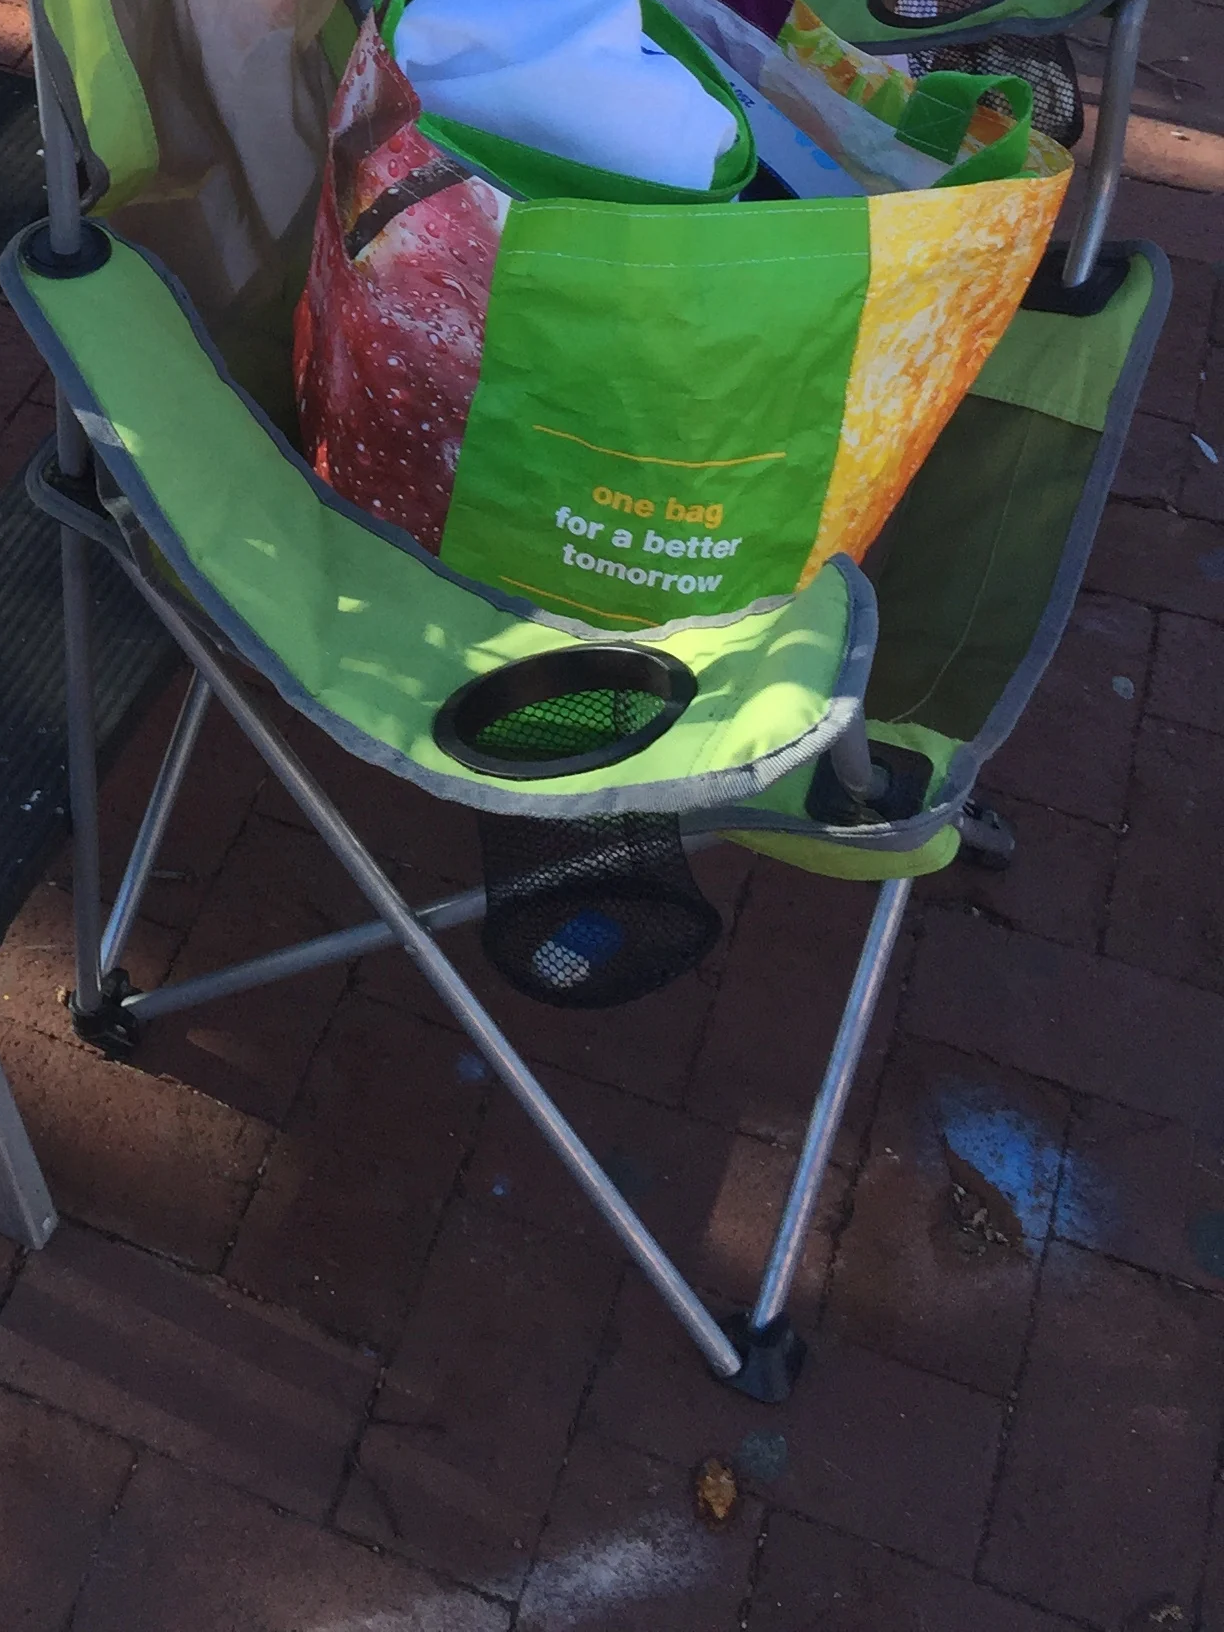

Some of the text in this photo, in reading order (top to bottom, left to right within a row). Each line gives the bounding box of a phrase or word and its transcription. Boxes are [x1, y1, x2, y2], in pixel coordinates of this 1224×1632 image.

[555, 506, 743, 559] for a better
[592, 486, 724, 530] one bag
[562, 542, 723, 594] tomorrow
